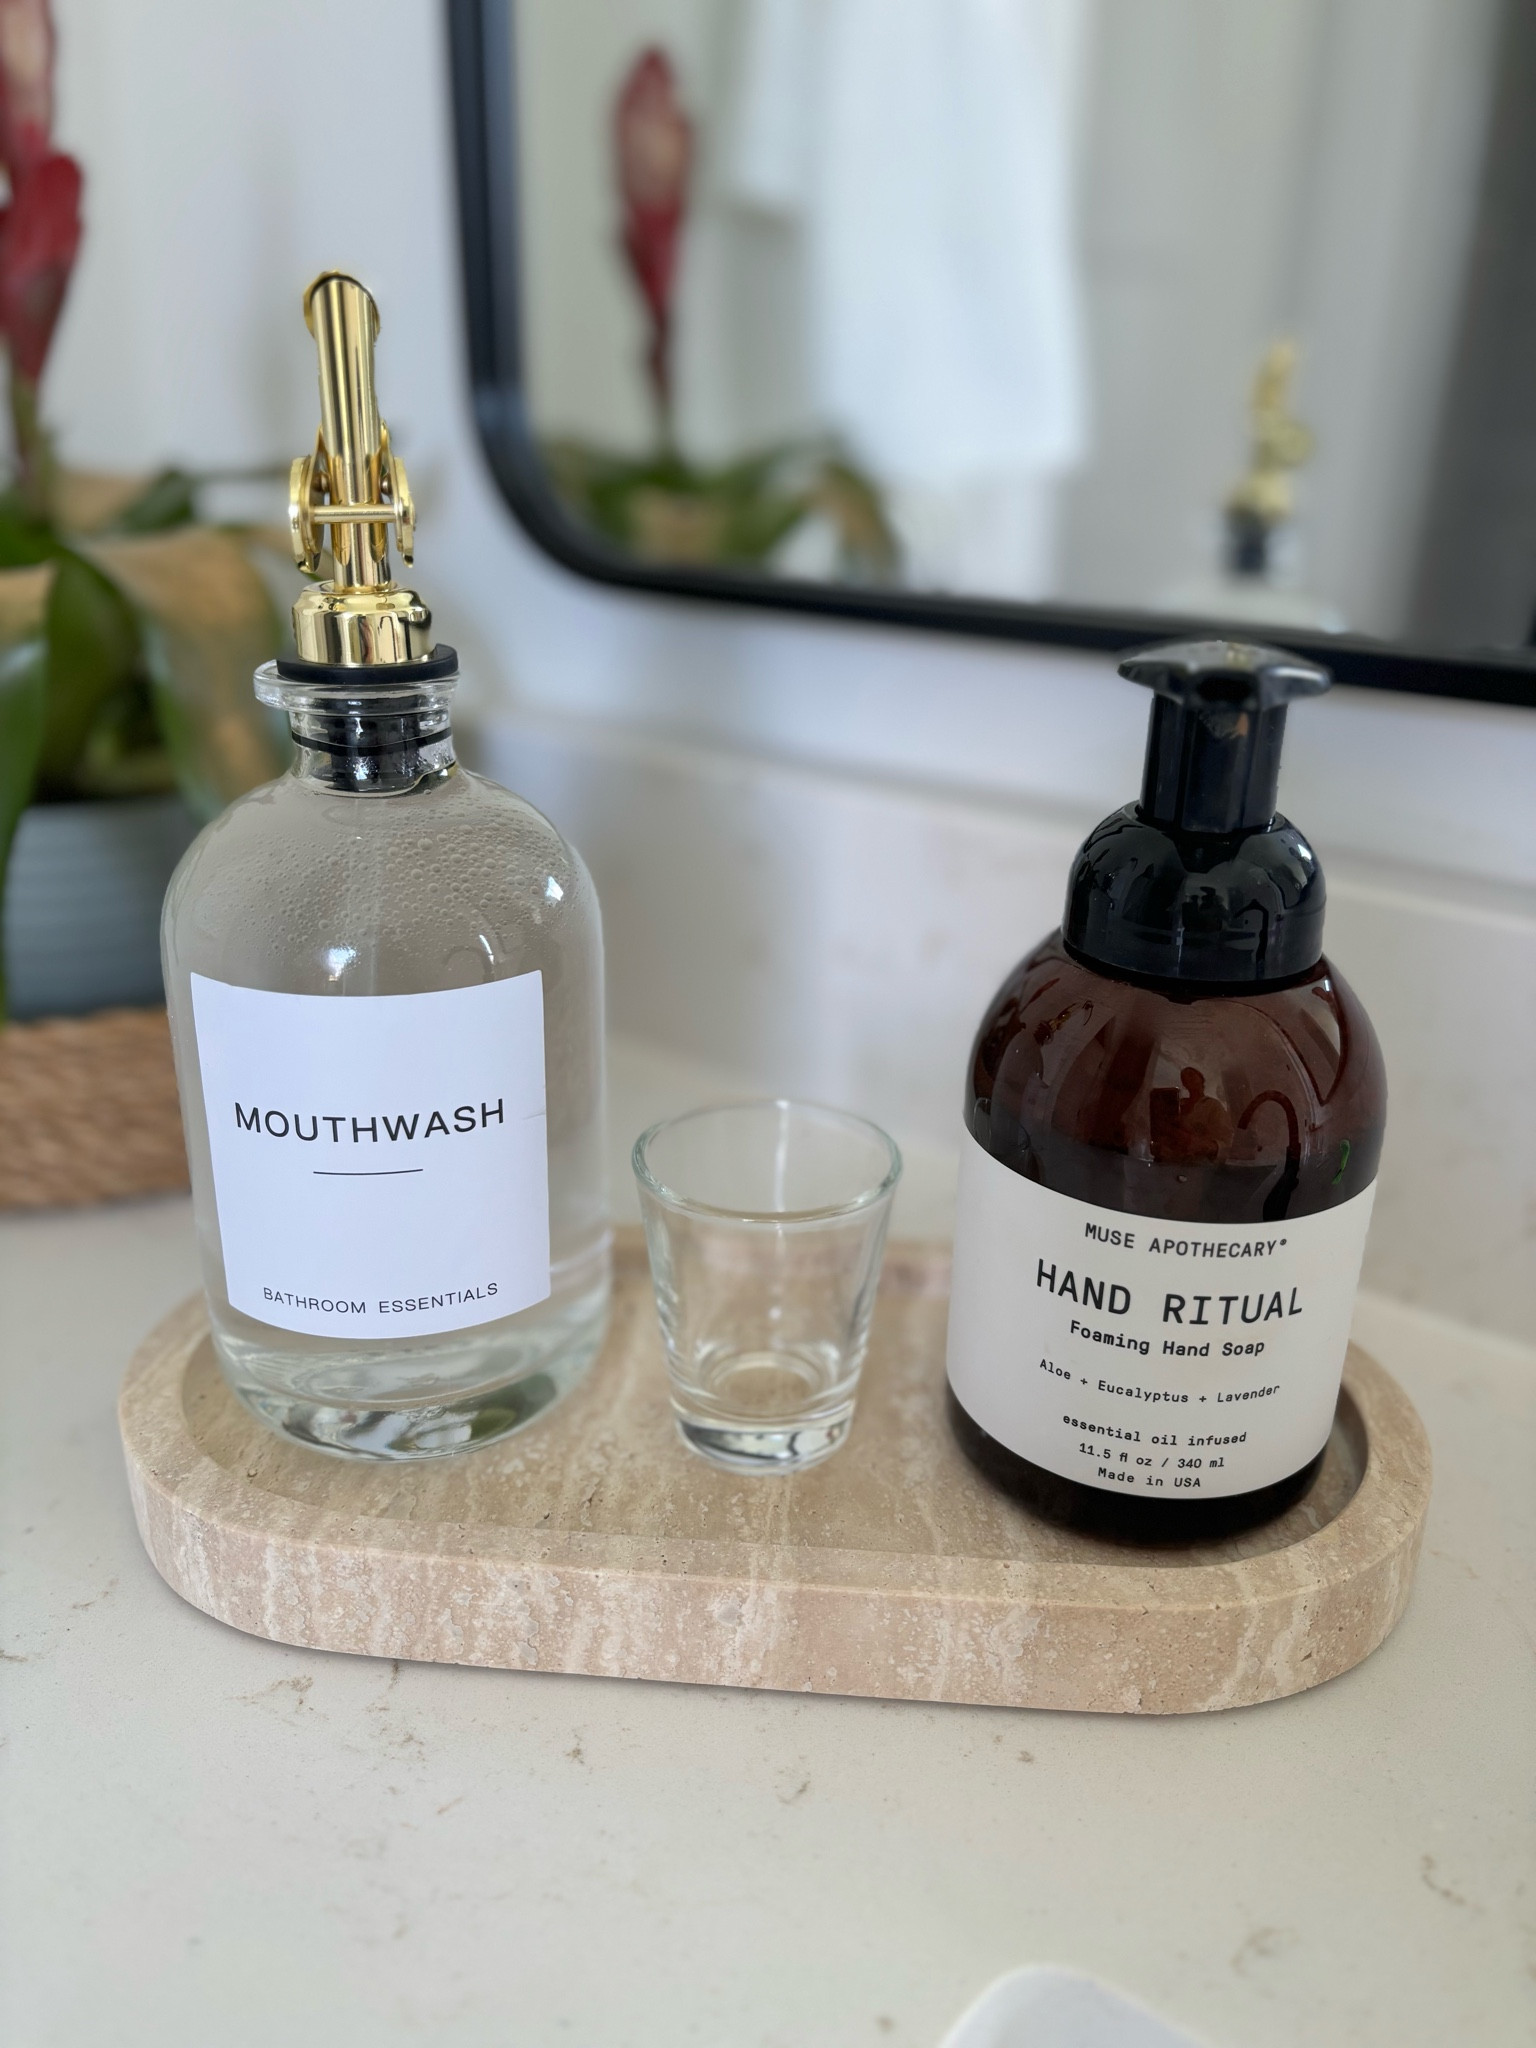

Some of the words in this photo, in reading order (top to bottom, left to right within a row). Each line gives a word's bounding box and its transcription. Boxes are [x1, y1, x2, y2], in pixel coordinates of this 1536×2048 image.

[234, 1097, 504, 1144] MOUTHWASH
[1084, 1221, 1136, 1250] MUSE
[263, 1286, 367, 1314] BATHROOM
[378, 1282, 498, 1314] ESSENTIALS
[1036, 1257, 1132, 1316] HAND
[1162, 1286, 1303, 1326] RITUAL
[1069, 1319, 1151, 1356] Foaming
[1162, 1339, 1211, 1358] Hand
[1221, 1341, 1265, 1358] Soap
[1039, 1358, 1072, 1381] Aloe
[1079, 1377, 1089, 1386] +
[1097, 1379, 1189, 1404] Eucalyptus
[1198, 1395, 1208, 1403] +
[1216, 1384, 1281, 1403] Lavender
[1062, 1415, 1141, 1443] essential
[1150, 1434, 1178, 1447] oil
[1187, 1431, 1247, 1447] infused
[1078, 1442, 1112, 1460] 11.5
[1118, 1451, 1129, 1463] fl
[1135, 1456, 1153, 1467] oz
[1160, 1457, 1170, 1468] /
[1176, 1457, 1203, 1469] 340
[1208, 1456, 1225, 1469] ml
[1097, 1466, 1135, 1484] Made
[1145, 1474, 1164, 1487] in
[1173, 1476, 1201, 1488] USA
